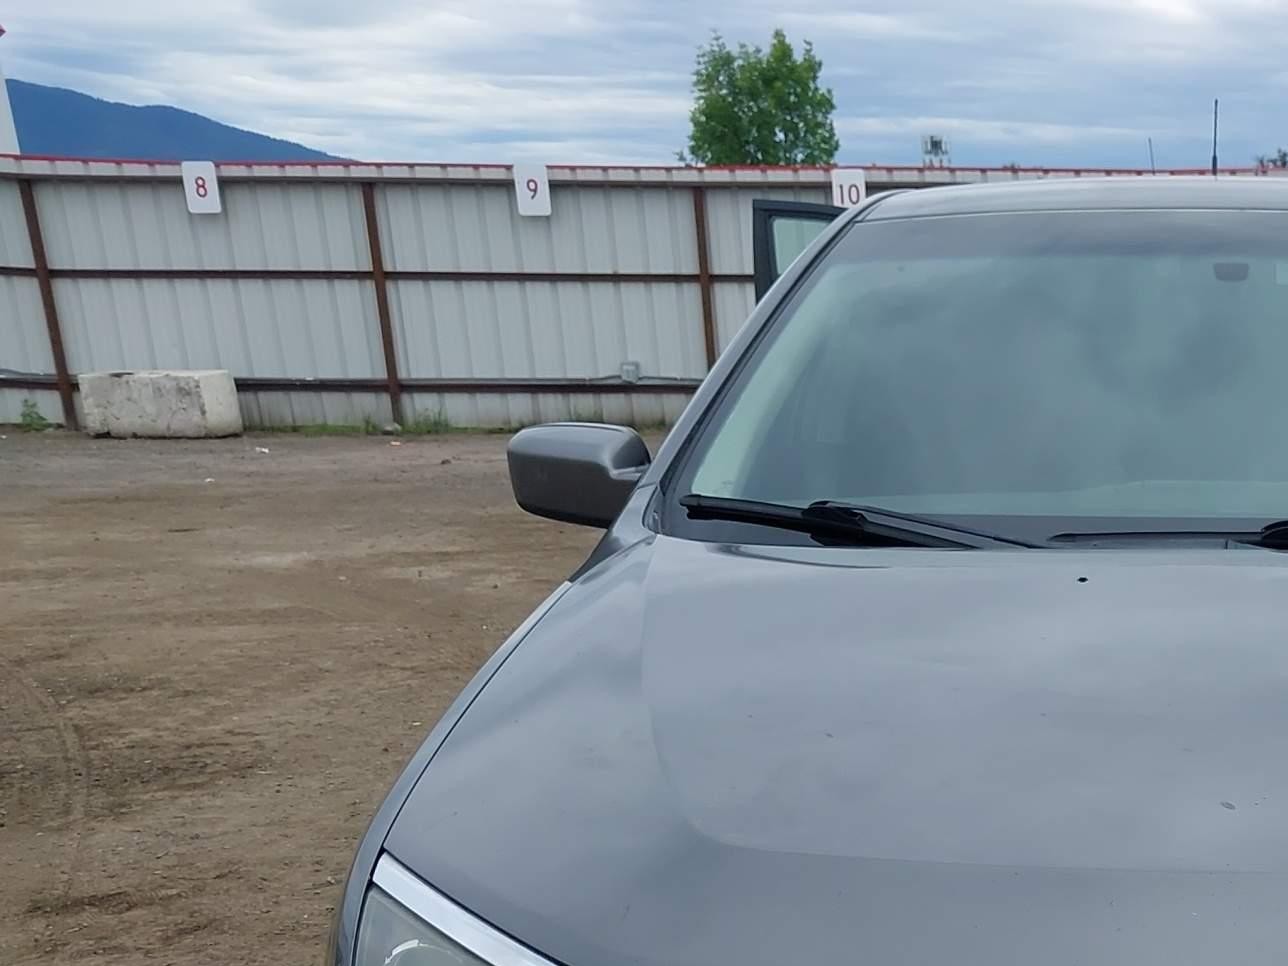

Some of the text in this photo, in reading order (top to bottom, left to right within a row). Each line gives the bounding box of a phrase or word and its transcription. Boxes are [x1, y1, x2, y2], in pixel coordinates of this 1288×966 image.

[194, 176, 208, 198] 8
[526, 178, 538, 200] 9
[839, 183, 860, 205] 10
